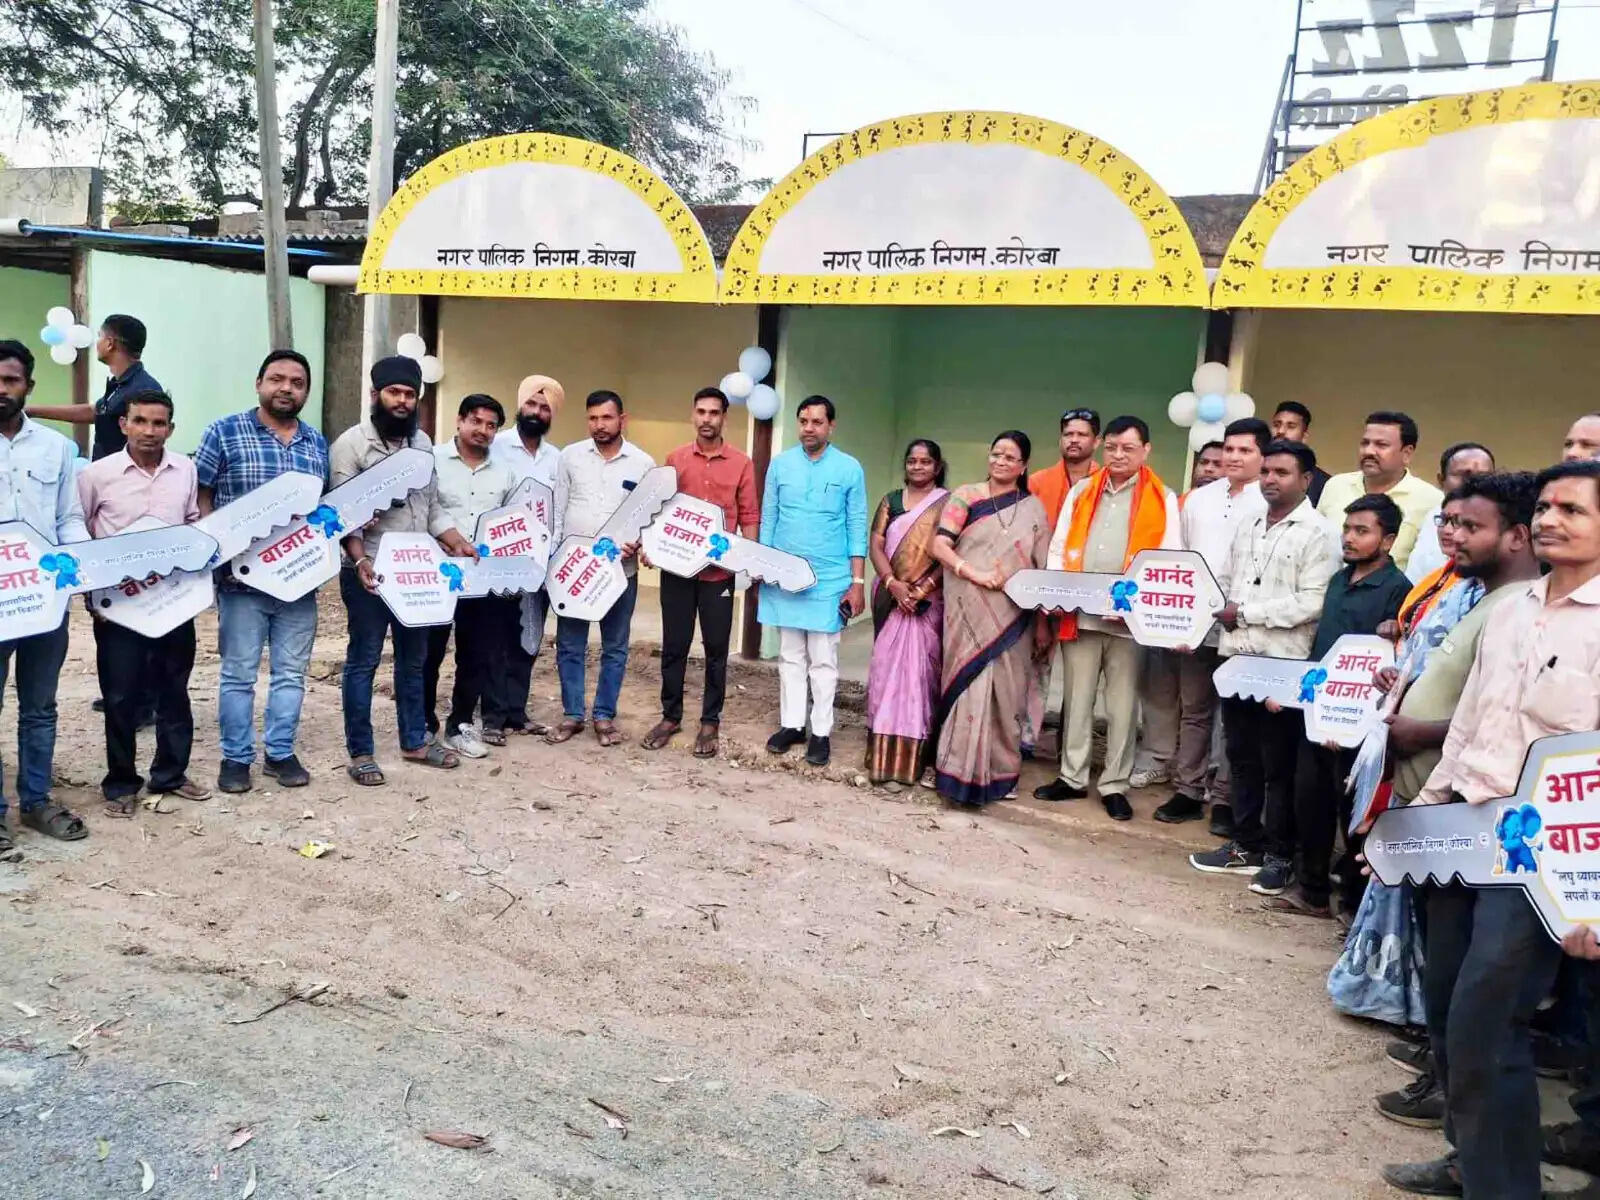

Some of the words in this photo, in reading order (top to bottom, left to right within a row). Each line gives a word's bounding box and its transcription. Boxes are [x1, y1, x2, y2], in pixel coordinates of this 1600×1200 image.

[437, 248, 471, 266] नगर
[477, 243, 525, 266] पालिक
[587, 242, 636, 268] कोरबा
[823, 250, 862, 271] नगर
[867, 242, 926, 268] पालिक
[1326, 244, 1389, 263] नगर
[1407, 239, 1505, 269] पालिक
[489, 516, 527, 540] आनंद
[671, 506, 712, 531] आनंद
[257, 525, 314, 563] बाजार
[664, 522, 706, 547] बाजार
[0, 540, 31, 561] नंद
[392, 545, 433, 564] आनंद
[555, 546, 588, 584] आनंद
[568, 557, 601, 596] बाजार
[1143, 564, 1195, 587] आनंद
[0, 568, 40, 590] जार
[394, 571, 439, 585] बाजार
[1140, 591, 1196, 610] बाजार
[1335, 649, 1382, 673] आनंद
[1325, 680, 1374, 700] बाजार
[1545, 822, 1600, 853] बाज
